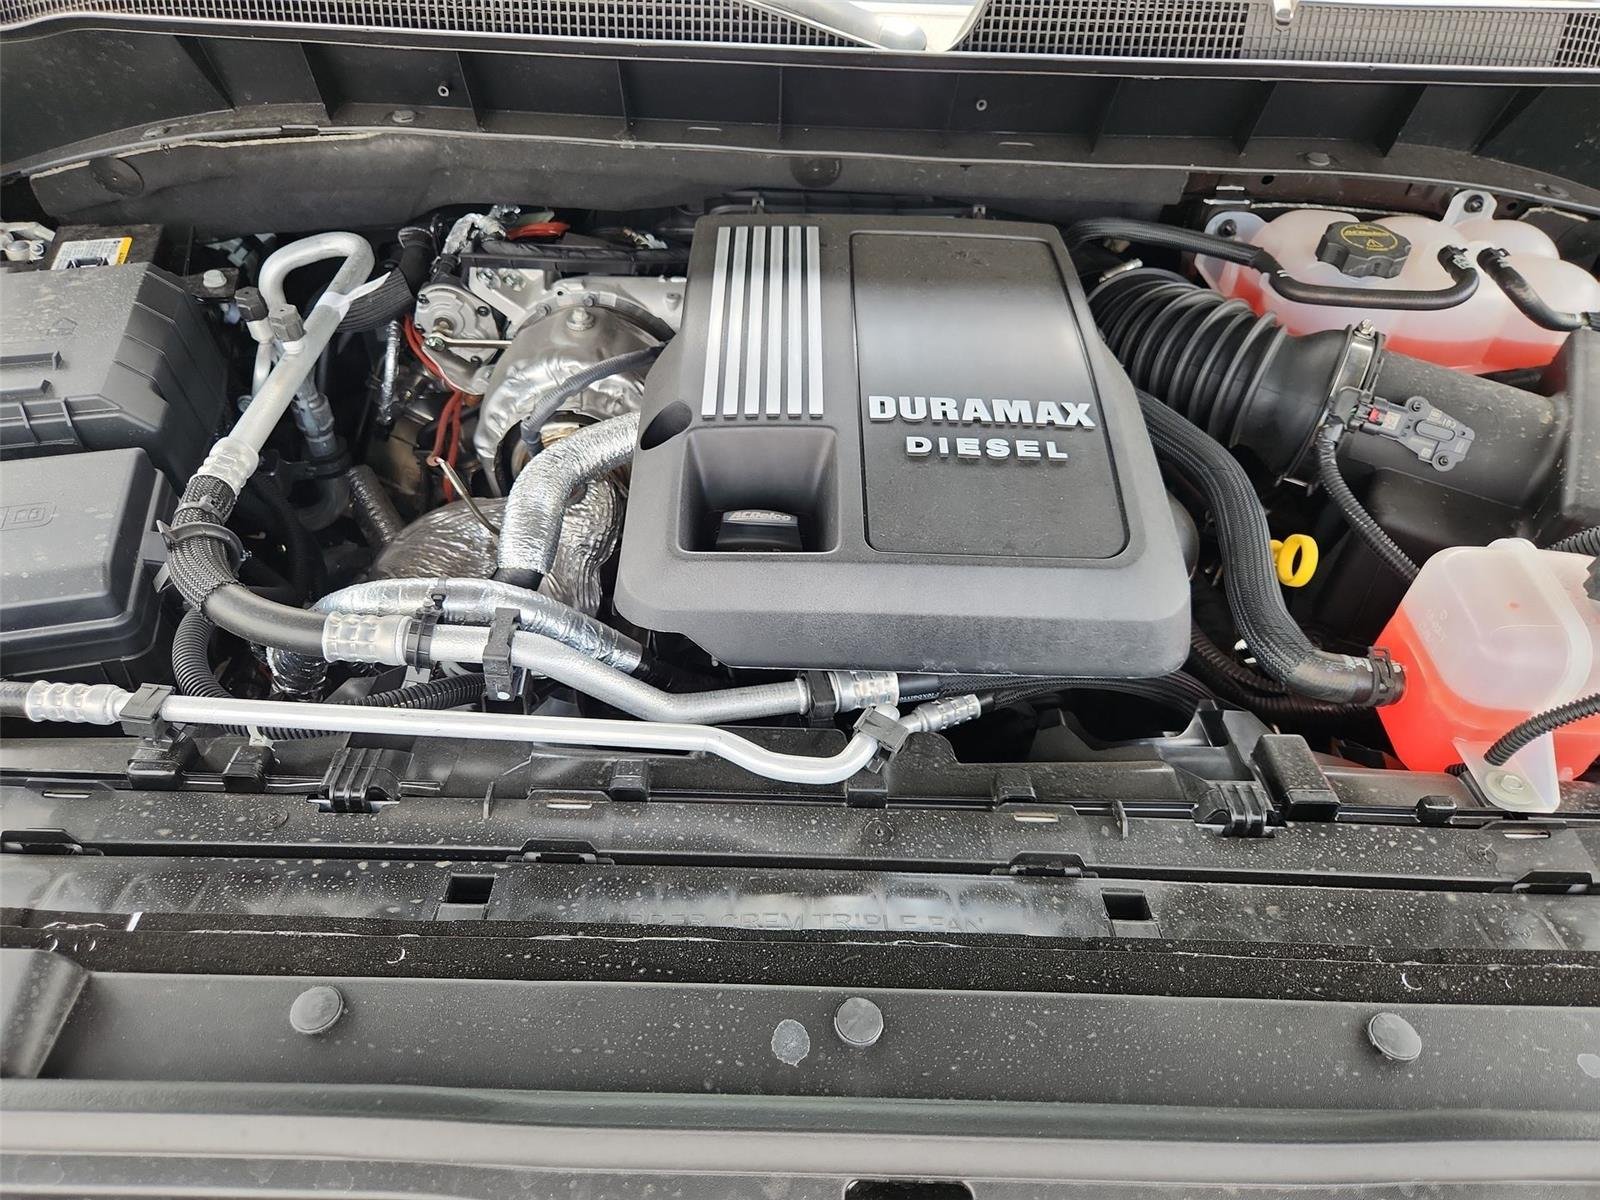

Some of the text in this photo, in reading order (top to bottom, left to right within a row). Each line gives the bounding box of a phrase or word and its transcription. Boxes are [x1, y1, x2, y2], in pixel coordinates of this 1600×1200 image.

[868, 395, 1096, 430] DURAMAX
[906, 436, 1069, 461] DIESEL
[728, 511, 792, 521] ACDelco
